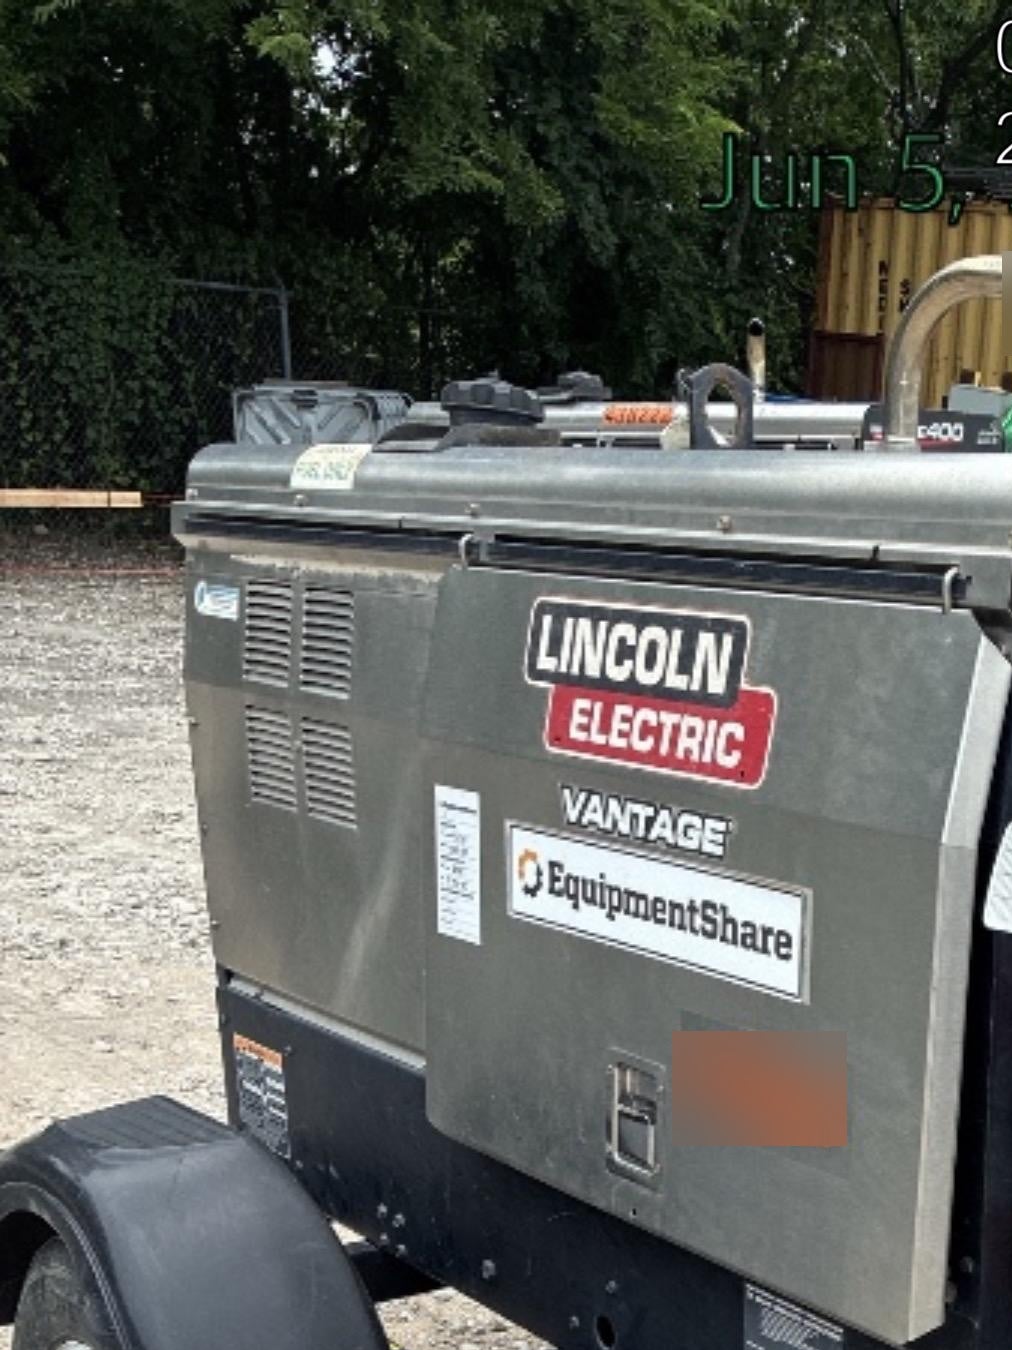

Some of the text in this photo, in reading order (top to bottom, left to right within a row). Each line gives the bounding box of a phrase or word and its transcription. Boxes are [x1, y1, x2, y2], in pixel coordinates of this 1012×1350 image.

[536, 614, 733, 694] LINCOLN
[567, 697, 746, 770] ELECTRIC
[560, 785, 730, 858] VANTAGE
[547, 860, 795, 962] EquipmentShare
